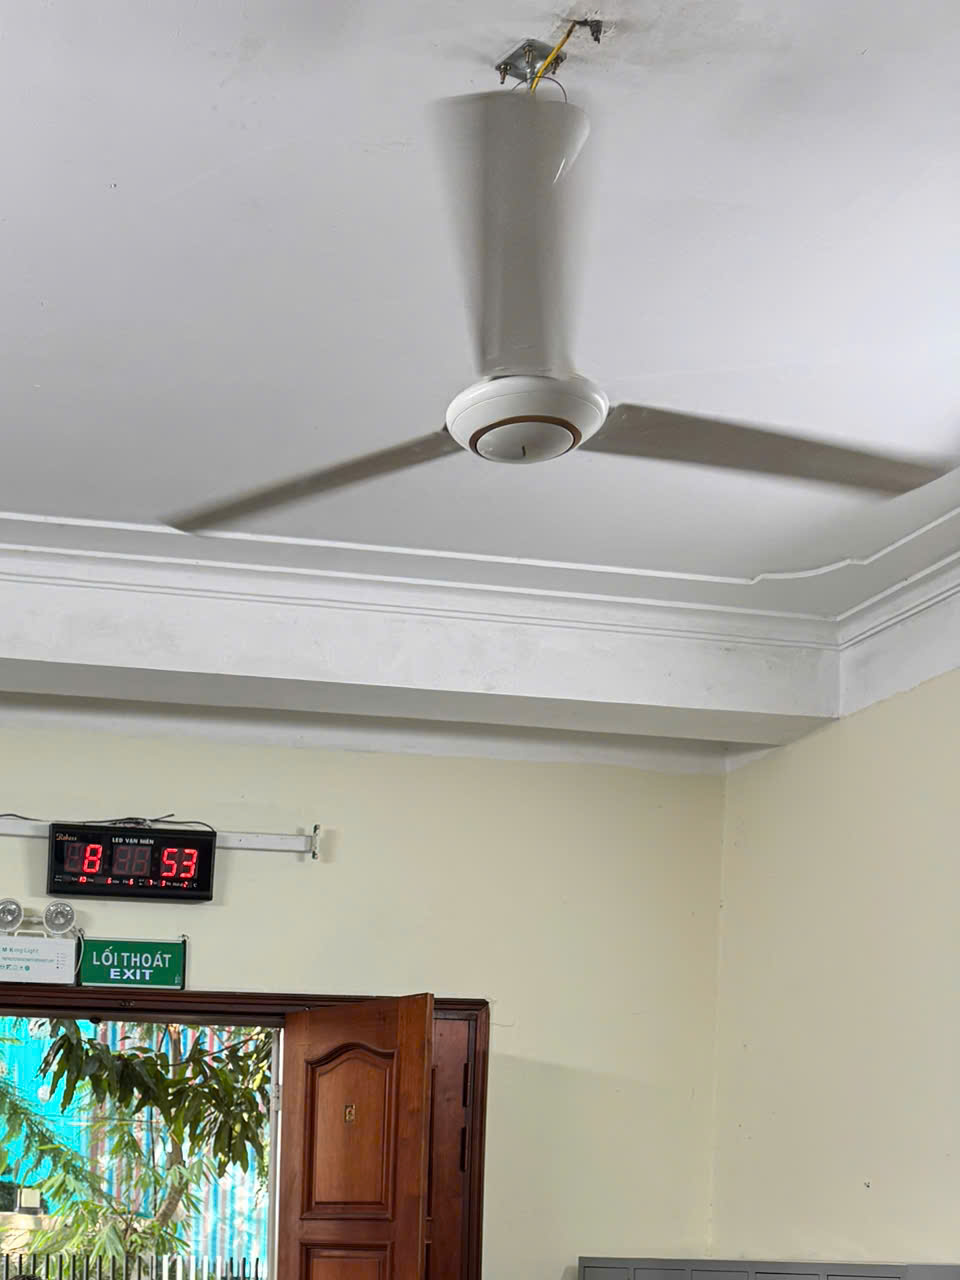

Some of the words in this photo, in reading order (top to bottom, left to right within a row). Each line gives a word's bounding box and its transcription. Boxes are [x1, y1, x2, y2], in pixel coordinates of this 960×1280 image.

[82, 843, 102, 873] 8
[161, 848, 198, 878] 53
[93, 946, 118, 966] LỐI
[121, 951, 172, 968] THOÁT
[110, 968, 153, 980] EXIT
